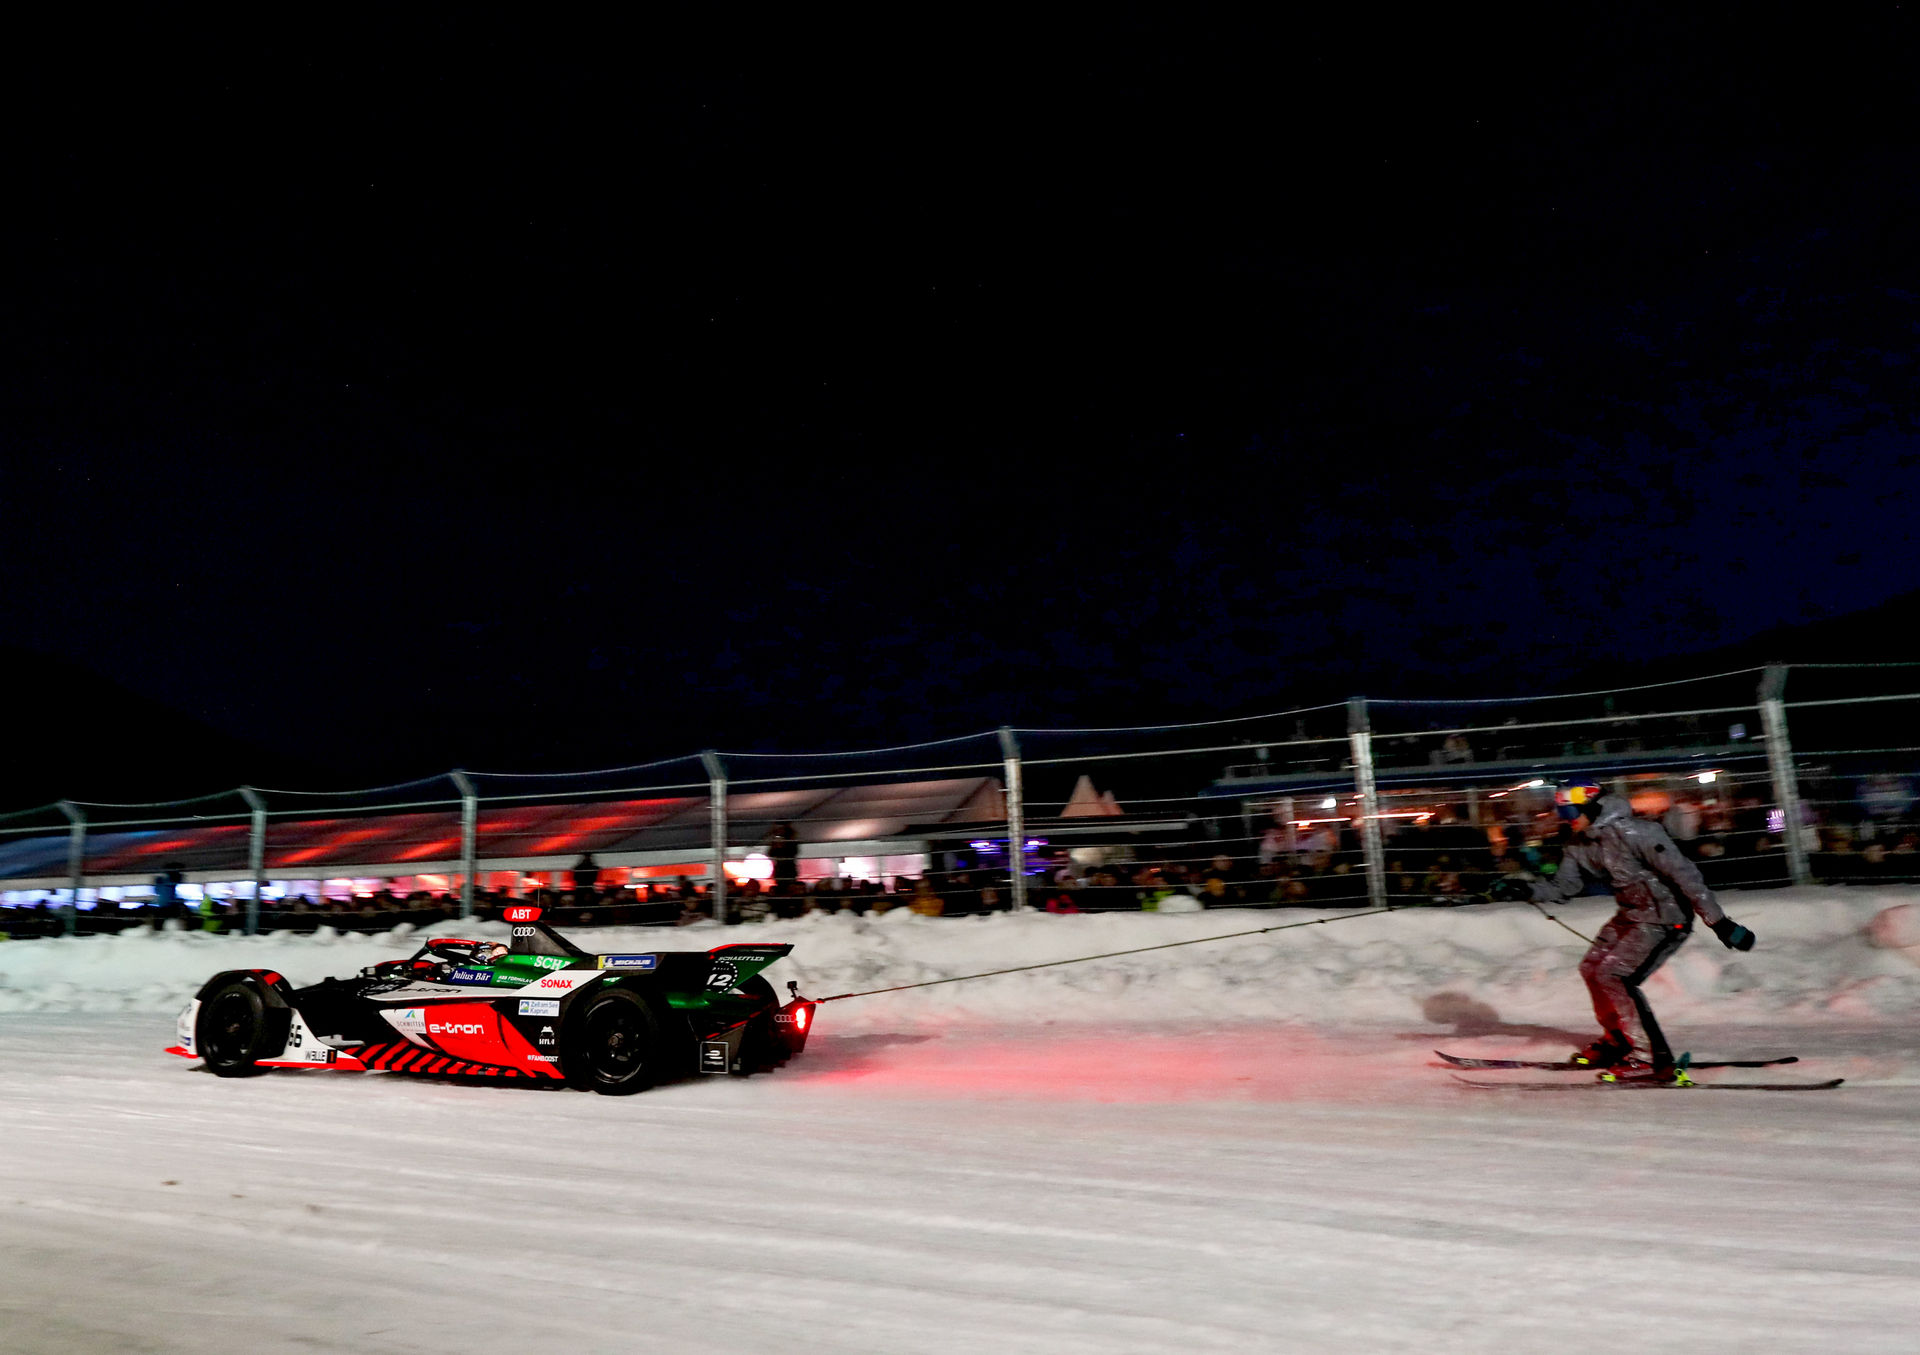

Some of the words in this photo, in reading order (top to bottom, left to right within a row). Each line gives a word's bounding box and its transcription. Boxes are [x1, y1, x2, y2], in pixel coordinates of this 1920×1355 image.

[511, 909, 531, 919] ABT
[452, 970, 474, 980] Julius
[475, 972, 490, 981] Bär
[706, 973, 732, 987] 12
[541, 979, 572, 989] SONAX
[429, 1022, 484, 1035] e-tron
